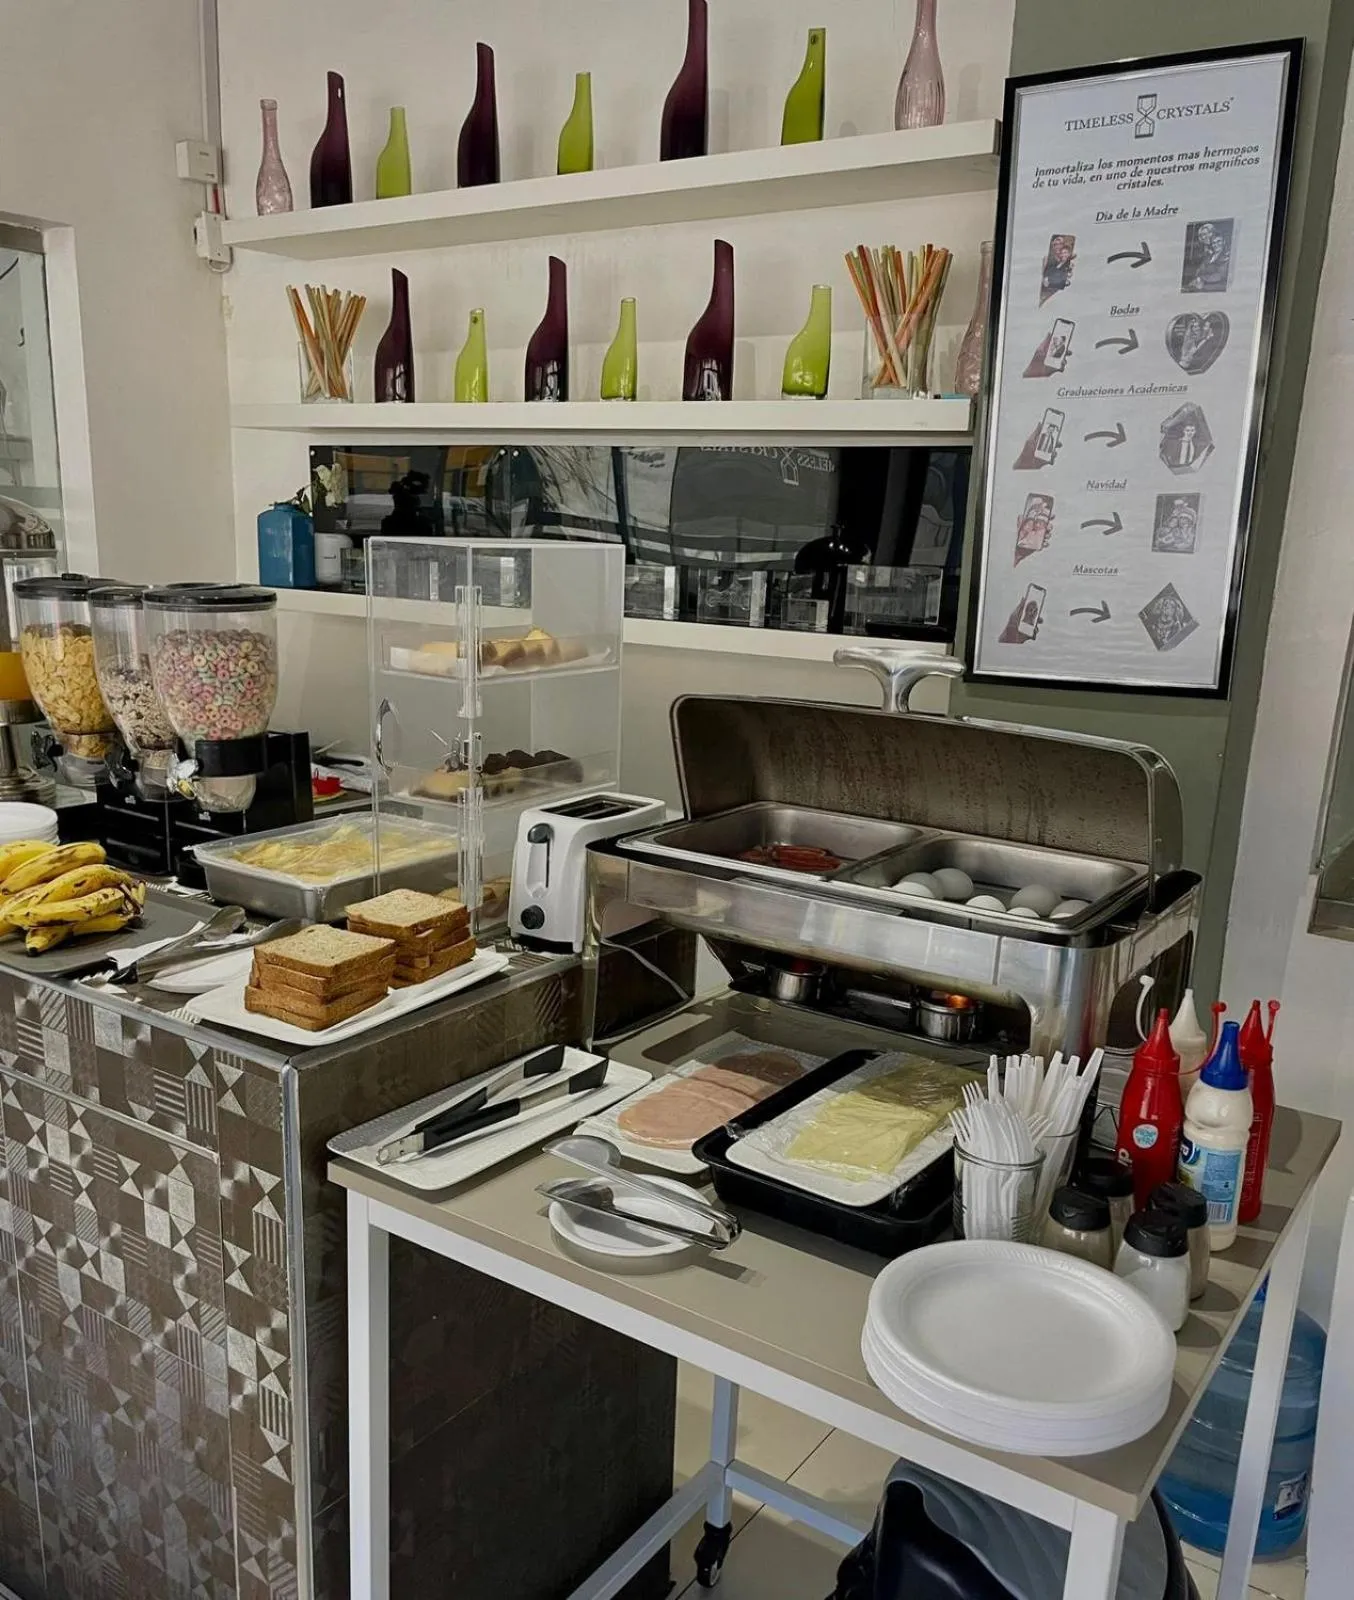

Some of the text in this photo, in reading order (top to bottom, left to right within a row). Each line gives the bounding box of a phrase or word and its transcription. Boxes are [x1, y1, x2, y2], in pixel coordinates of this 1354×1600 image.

[1065, 100, 1231, 132] TIMELESS CRYSTALS
[1035, 145, 1260, 177] Inmortaliza los momentos mas hermosos
[1032, 177, 1046, 189] de
[1048, 178, 1060, 188] tu
[1062, 173, 1087, 186] vida,
[1089, 174, 1103, 183] en
[1106, 170, 1128, 182] uno
[1130, 166, 1144, 178] de
[1146, 163, 1195, 176] nuestros
[1116, 176, 1165, 191] cristales.
[1116, 208, 1130, 220] de
[1132, 207, 1142, 218] la
[1144, 204, 1180, 217] Madre
[1110, 304, 1140, 316] Bodas
[1057, 386, 1125, 397] Graduaciones
[1086, 479, 1127, 490] Navidad
[1073, 564, 1119, 575] Mascotas
